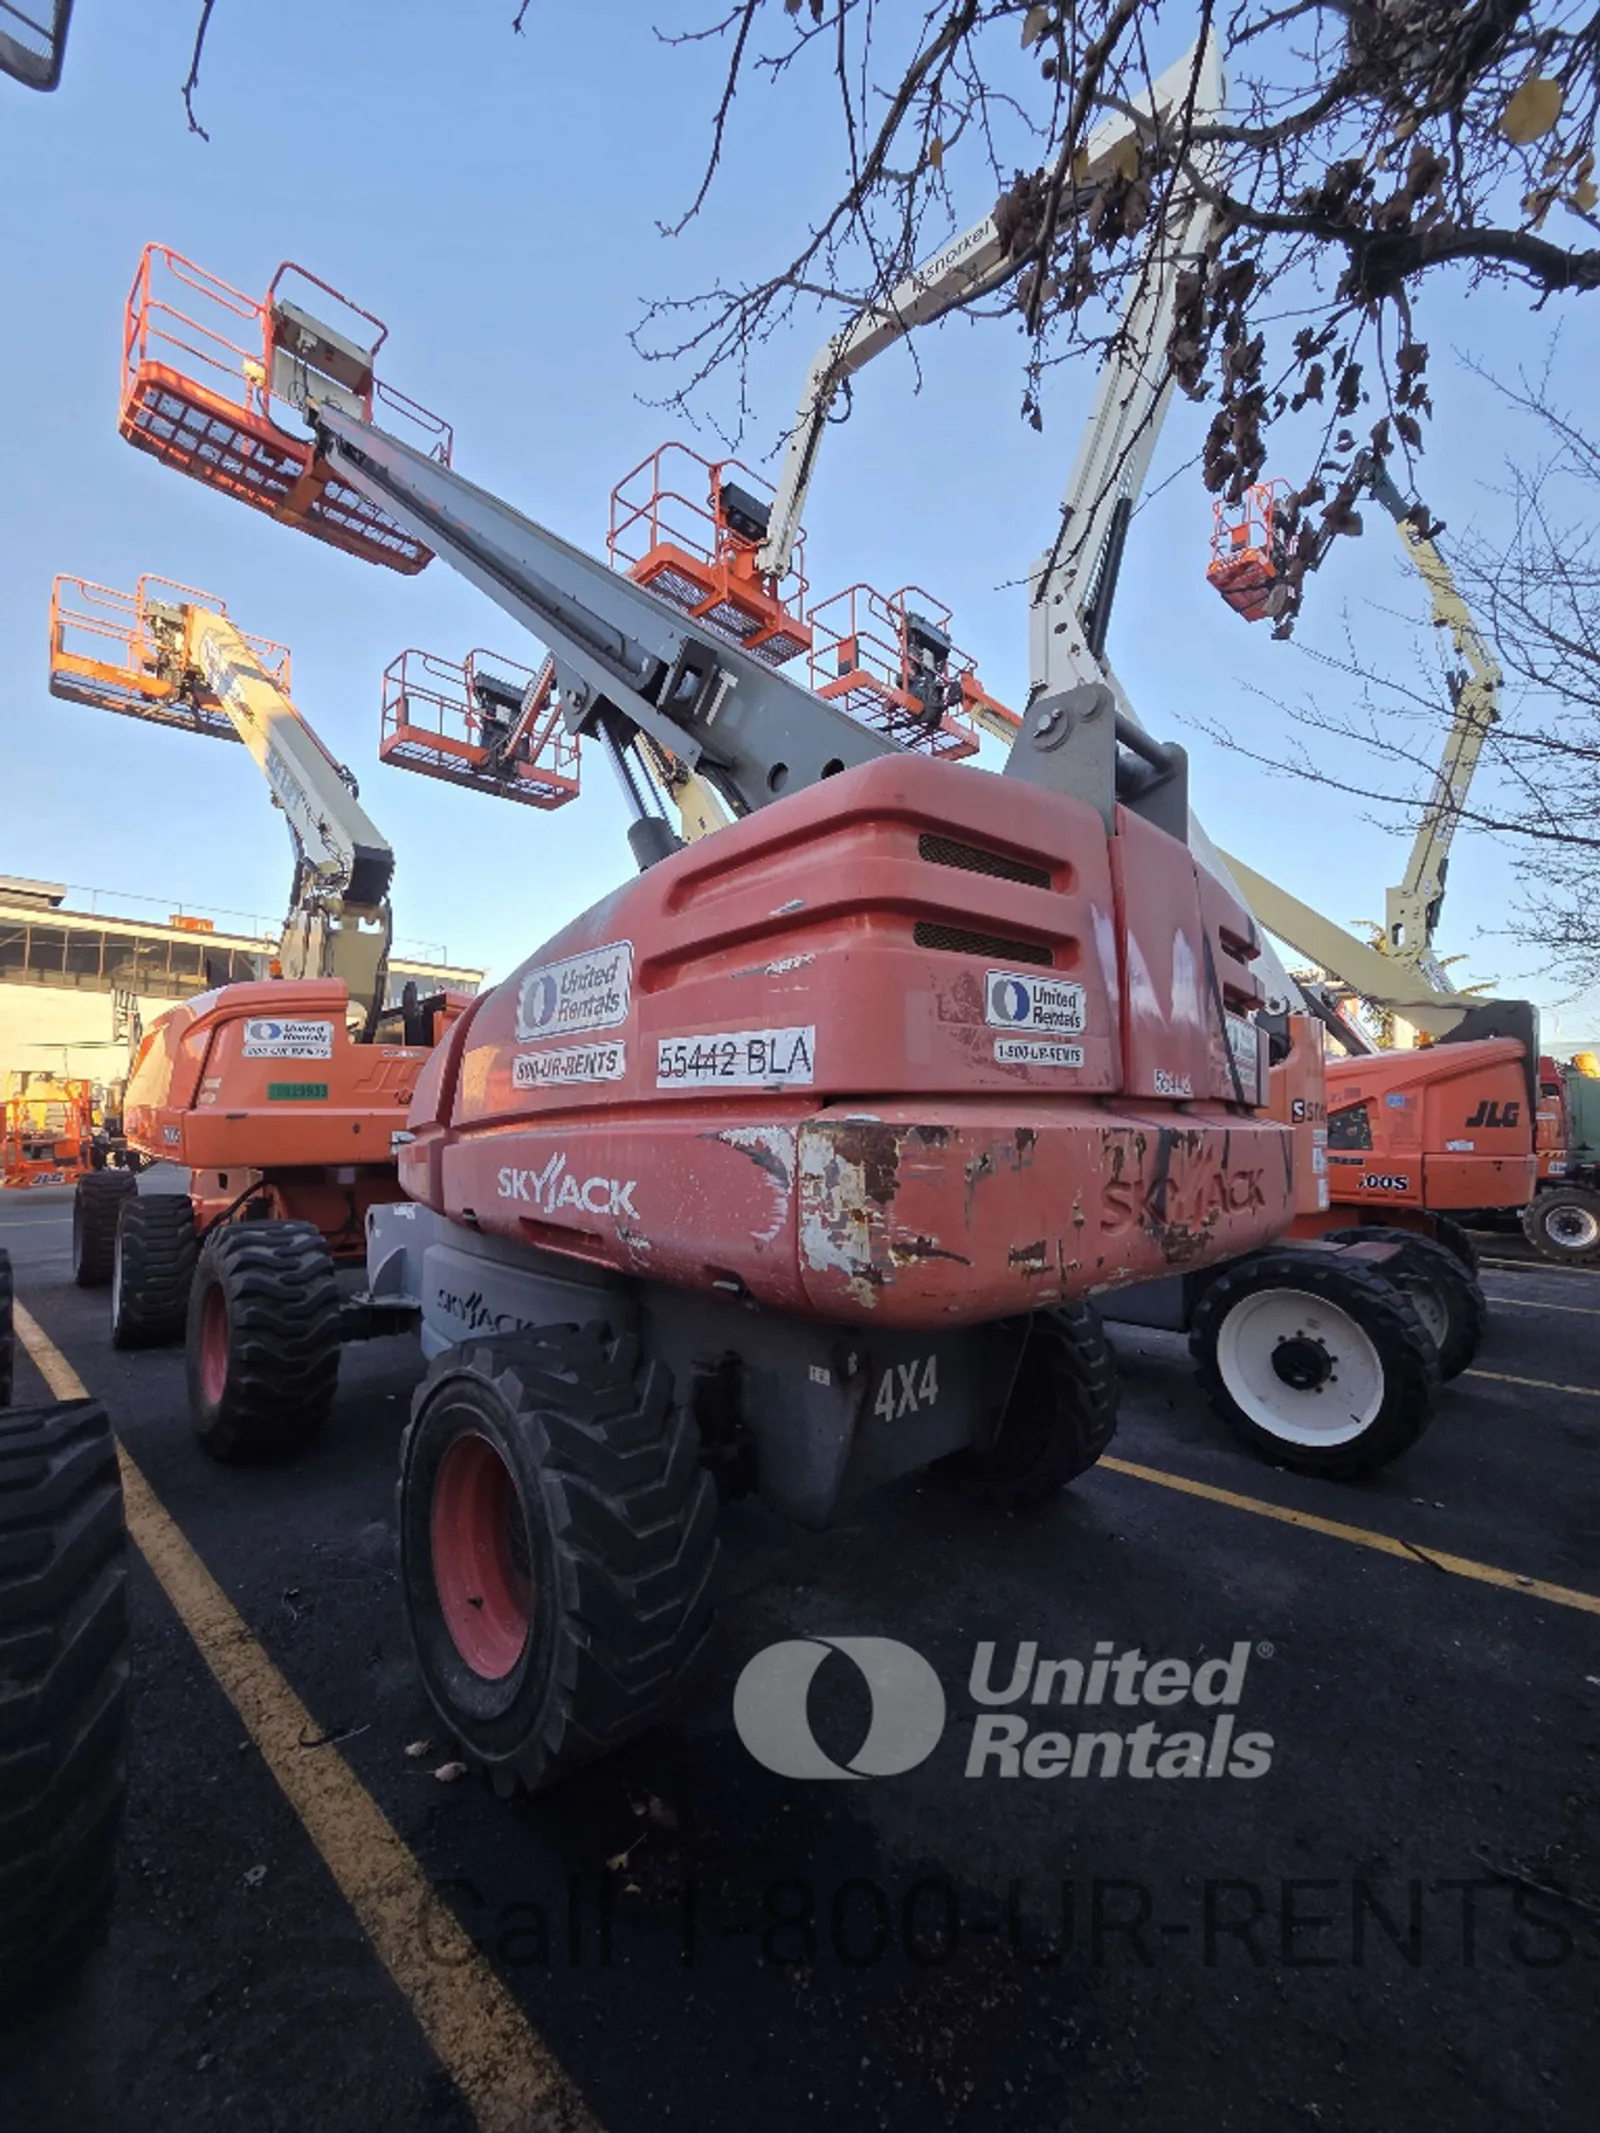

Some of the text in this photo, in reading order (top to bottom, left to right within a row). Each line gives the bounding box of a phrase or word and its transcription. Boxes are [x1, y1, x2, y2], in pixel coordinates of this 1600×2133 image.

[925, 220, 990, 281] snorkel
[561, 956, 621, 994] United
[557, 990, 621, 1021] Rentals
[1033, 985, 1077, 1010] United
[1033, 1006, 1082, 1029] Rentals
[659, 1034, 813, 1078] 55442 BLA
[1465, 1100, 1520, 1128] JLG
[497, 1151, 641, 1220] SKYJACK
[873, 1353, 940, 1423] 4X4
